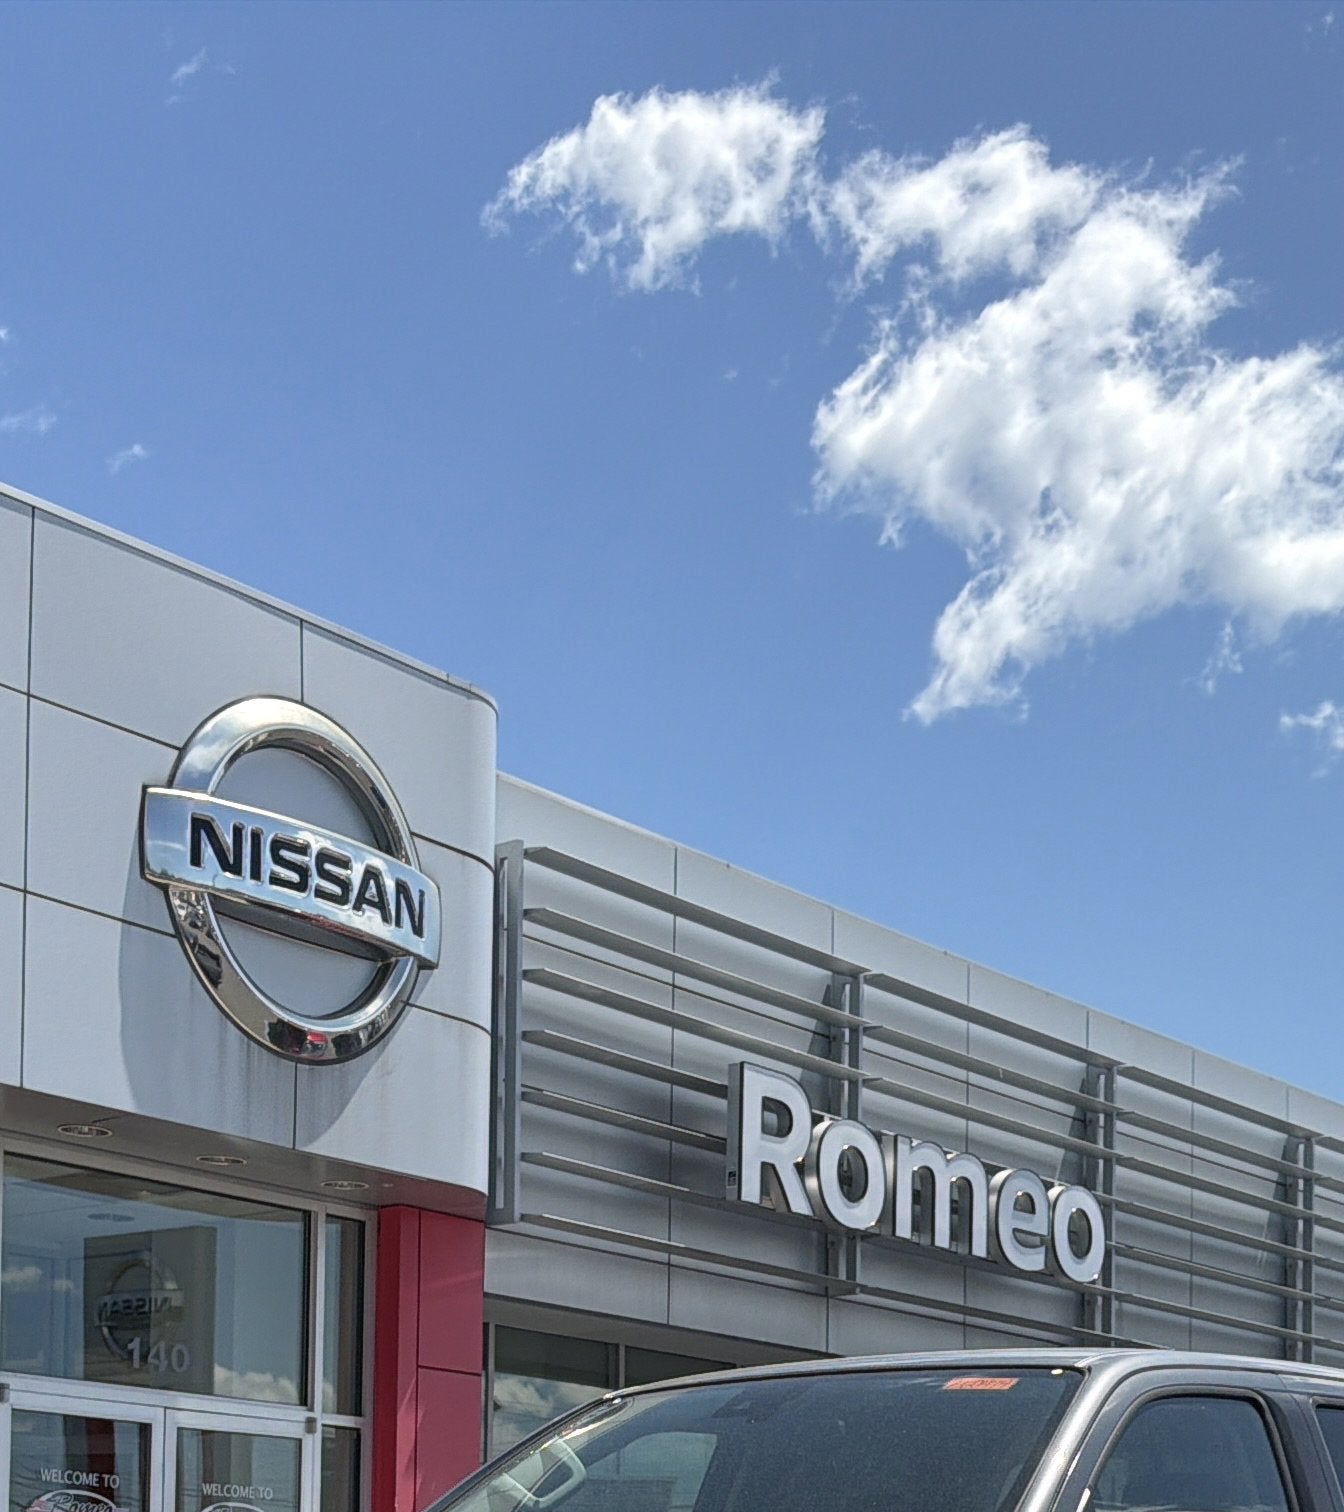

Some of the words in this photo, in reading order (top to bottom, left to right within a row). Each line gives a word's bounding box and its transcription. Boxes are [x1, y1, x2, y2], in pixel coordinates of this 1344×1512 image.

[189, 812, 426, 940] NISSAN
[728, 1061, 1105, 1283] Romeo
[127, 1336, 190, 1373] 140
[40, 1468, 100, 1487] WELCOME
[102, 1474, 120, 1488] TO
[202, 1483, 256, 1498] WELCOME
[258, 1487, 273, 1499] TO
